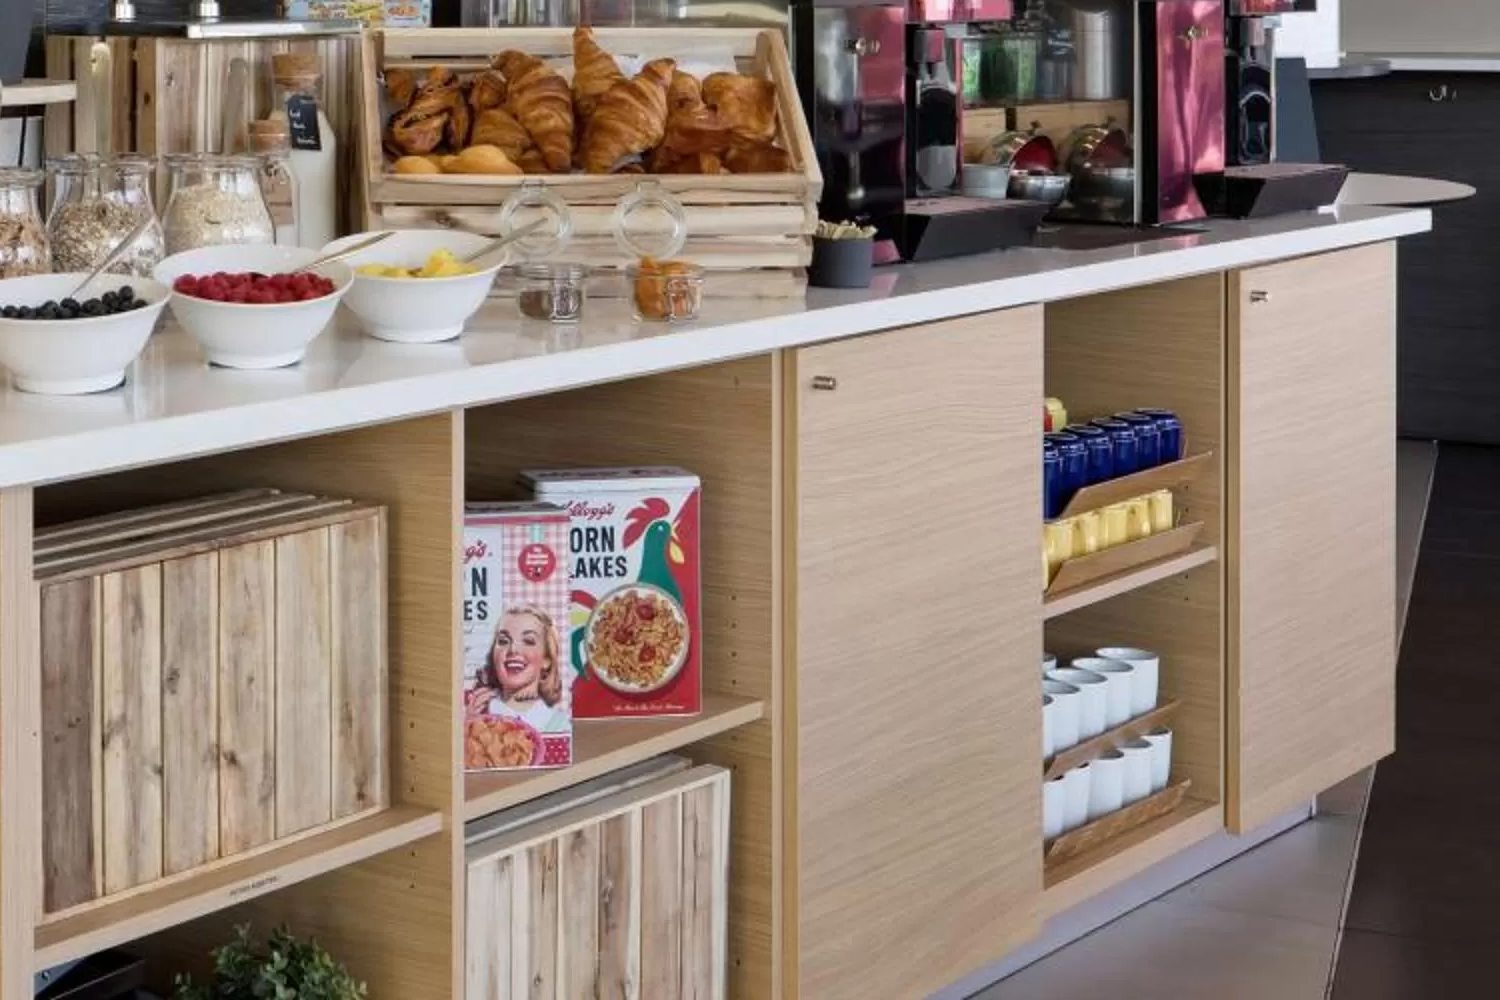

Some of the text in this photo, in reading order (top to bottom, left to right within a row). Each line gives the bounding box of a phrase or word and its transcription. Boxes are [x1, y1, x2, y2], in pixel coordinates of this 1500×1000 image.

[567, 500, 614, 520] ellogg's
[570, 526, 615, 553] ORN
[568, 556, 627, 578] AKES
